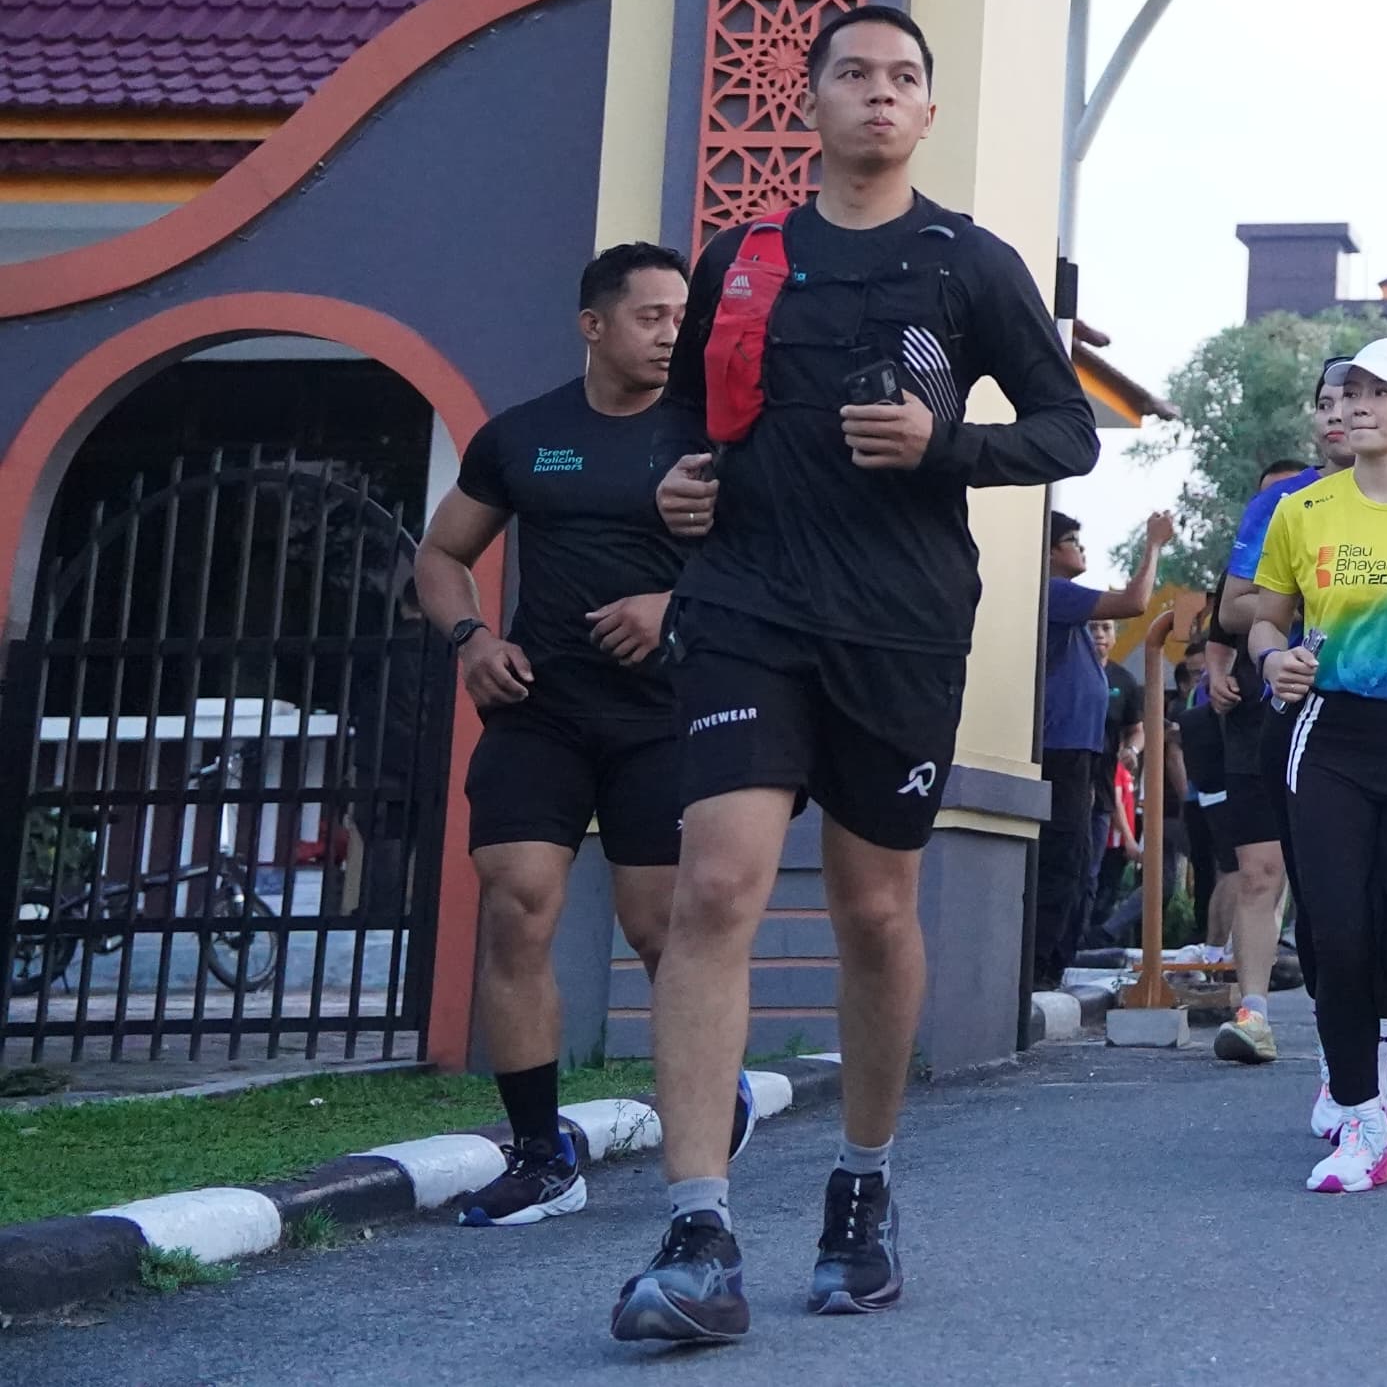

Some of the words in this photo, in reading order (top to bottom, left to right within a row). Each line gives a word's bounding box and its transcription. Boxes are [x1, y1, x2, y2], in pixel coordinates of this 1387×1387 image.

[538, 448, 574, 457] Green
[536, 454, 584, 465] Policing
[534, 464, 583, 472] Runners
[1337, 544, 1373, 558] Riau
[1333, 573, 1366, 586] Run
